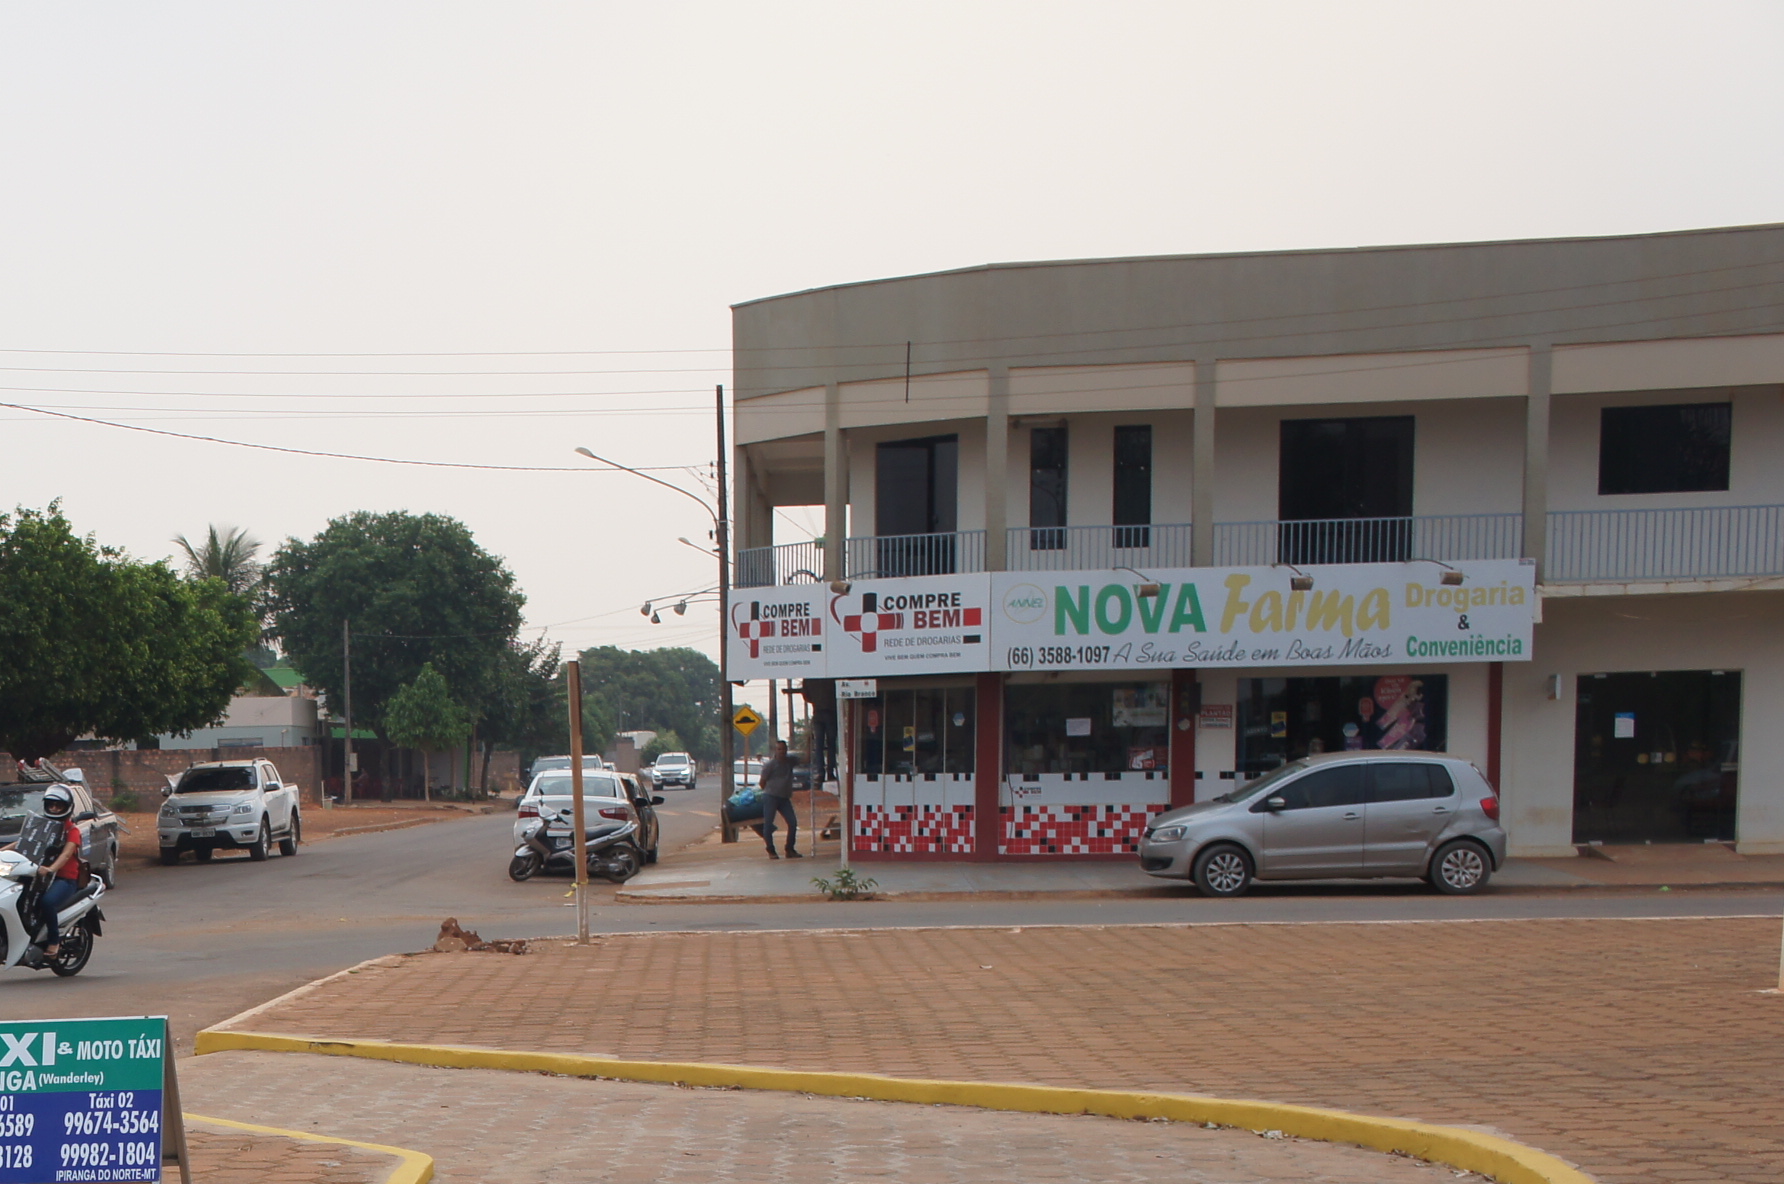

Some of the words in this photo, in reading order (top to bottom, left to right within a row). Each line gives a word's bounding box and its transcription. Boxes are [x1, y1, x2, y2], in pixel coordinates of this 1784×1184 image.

[883, 592, 961, 611] COMPRE
[1054, 582, 1207, 636] NOVA
[1219, 573, 1391, 638] Farma
[1405, 580, 1525, 613] Drogaria
[763, 602, 810, 618] COMPRE
[913, 609, 961, 629] BEM
[781, 618, 810, 637] BEM
[1458, 614, 1470, 630] &
[763, 645, 775, 653] REDE
[776, 645, 783, 653] DE
[783, 643, 810, 653] DROGARIAS
[883, 638, 903, 648] REDE
[905, 637, 914, 647] DE
[917, 635, 961, 646] DROGARIAS
[1113, 642, 1134, 664] A
[1136, 642, 1176, 663] Sua
[1182, 640, 1246, 663] Saúde
[1251, 647, 1279, 660] em
[1285, 639, 1333, 662] Boas
[1337, 638, 1393, 661] Mãos
[1406, 633, 1523, 657] Conveniência
[1007, 646, 1034, 669] (66)
[1038, 646, 1111, 665] 3588-1097
[57, 1041, 73, 1055] &
[76, 1040, 124, 1060] MOTO
[128, 1033, 161, 1059] TÁXI
[38, 1071, 104, 1088] (Wanderley)
[0, 1095, 14, 1111] 01
[89, 1092, 115, 1109] Táxi
[117, 1092, 134, 1108] 02
[64, 1110, 159, 1135] 99674-3564
[60, 1142, 155, 1167] 99982-1804
[56, 1169, 96, 1181] IPIRANGA
[98, 1169, 111, 1181] DO
[112, 1168, 157, 1180] NORTE-MT
